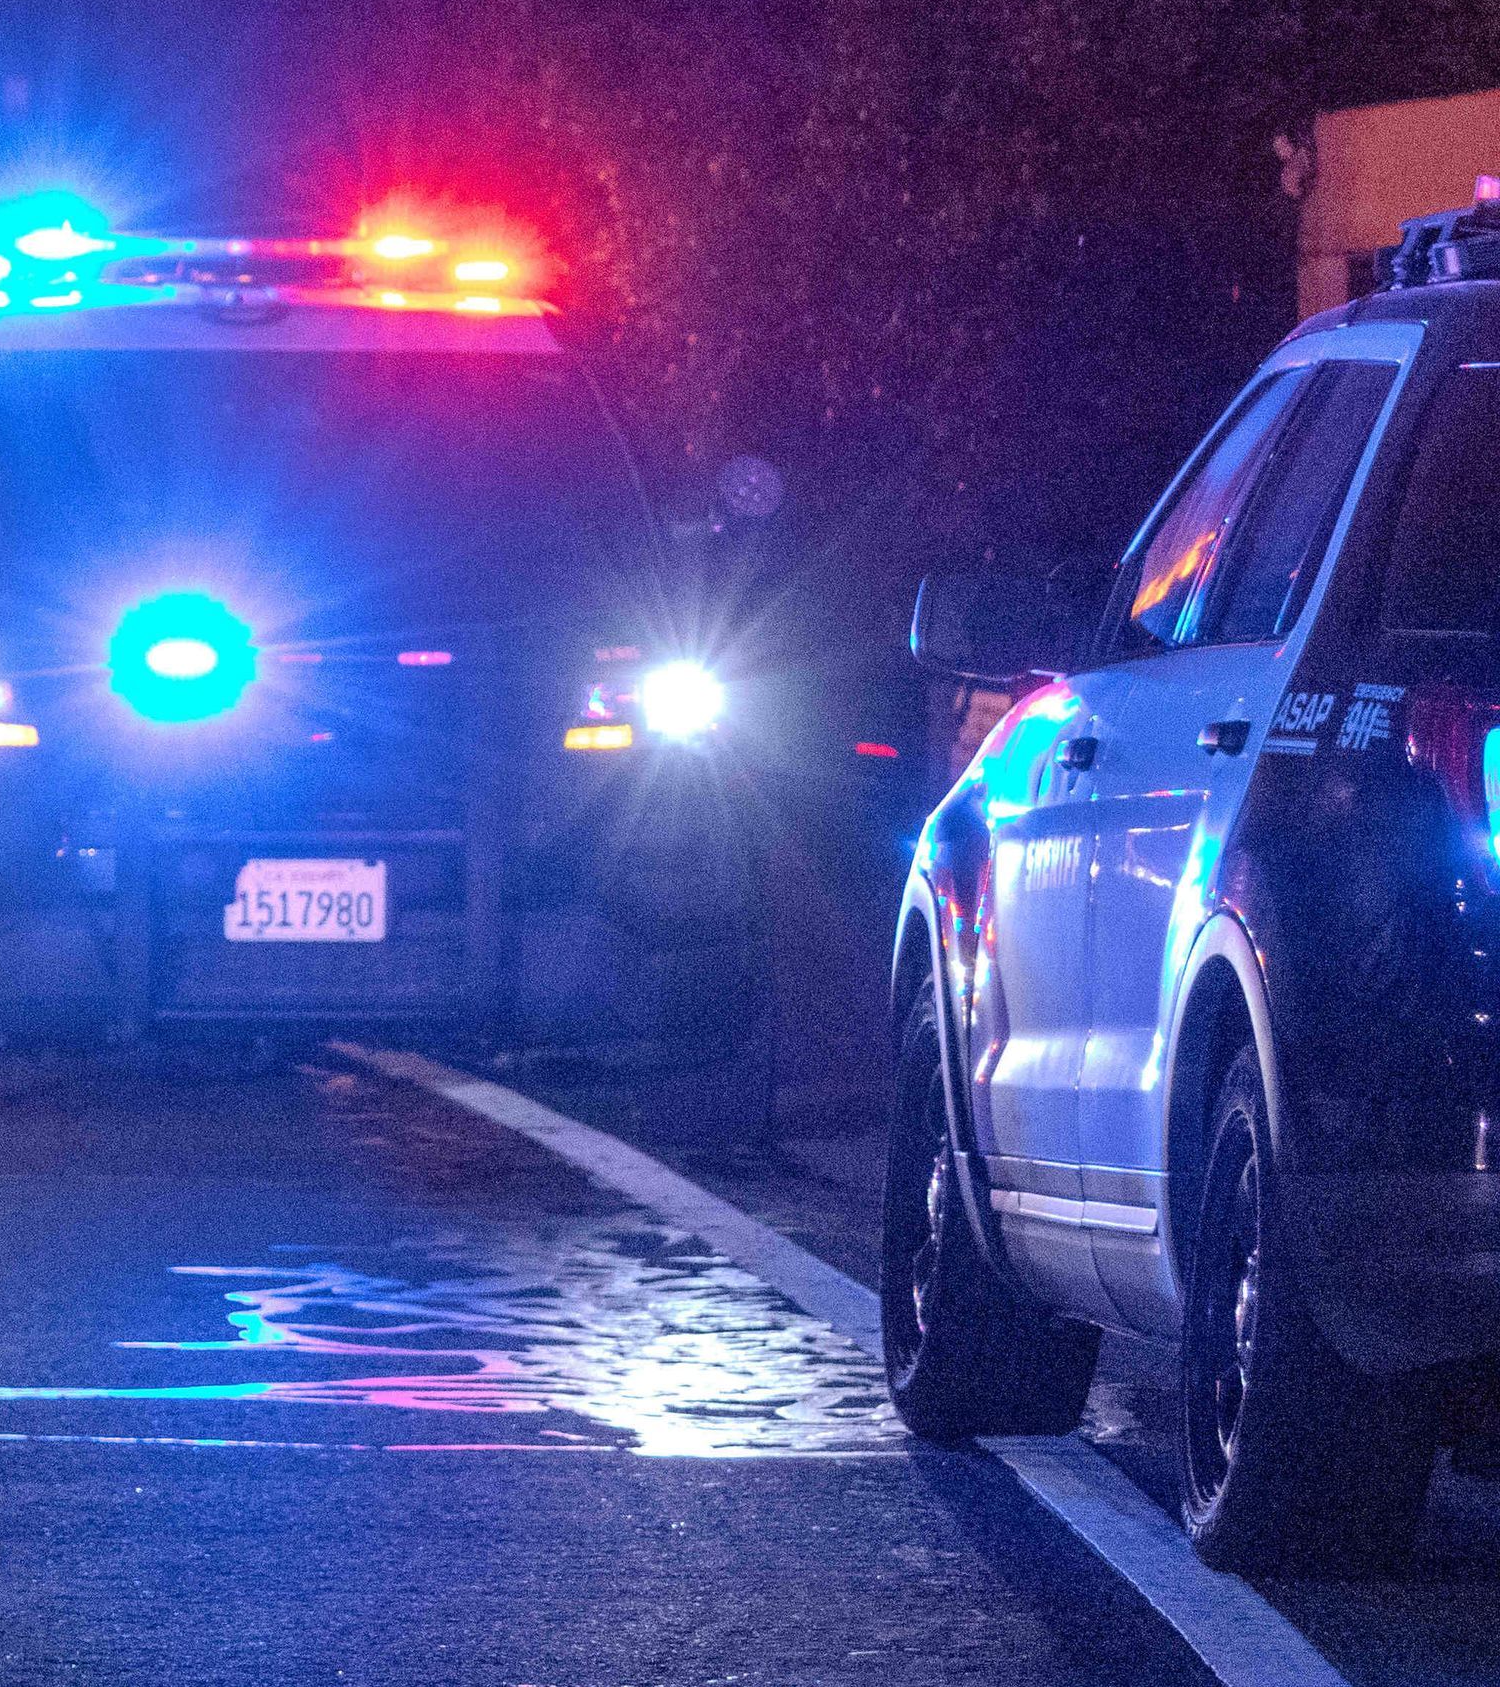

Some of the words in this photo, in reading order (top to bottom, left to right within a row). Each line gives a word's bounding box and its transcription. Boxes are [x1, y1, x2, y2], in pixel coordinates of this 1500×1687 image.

[1271, 692, 1335, 732] ASAP
[1341, 700, 1382, 750] 911
[1026, 836, 1082, 892] SHERIFF
[237, 890, 373, 927] 1517980
